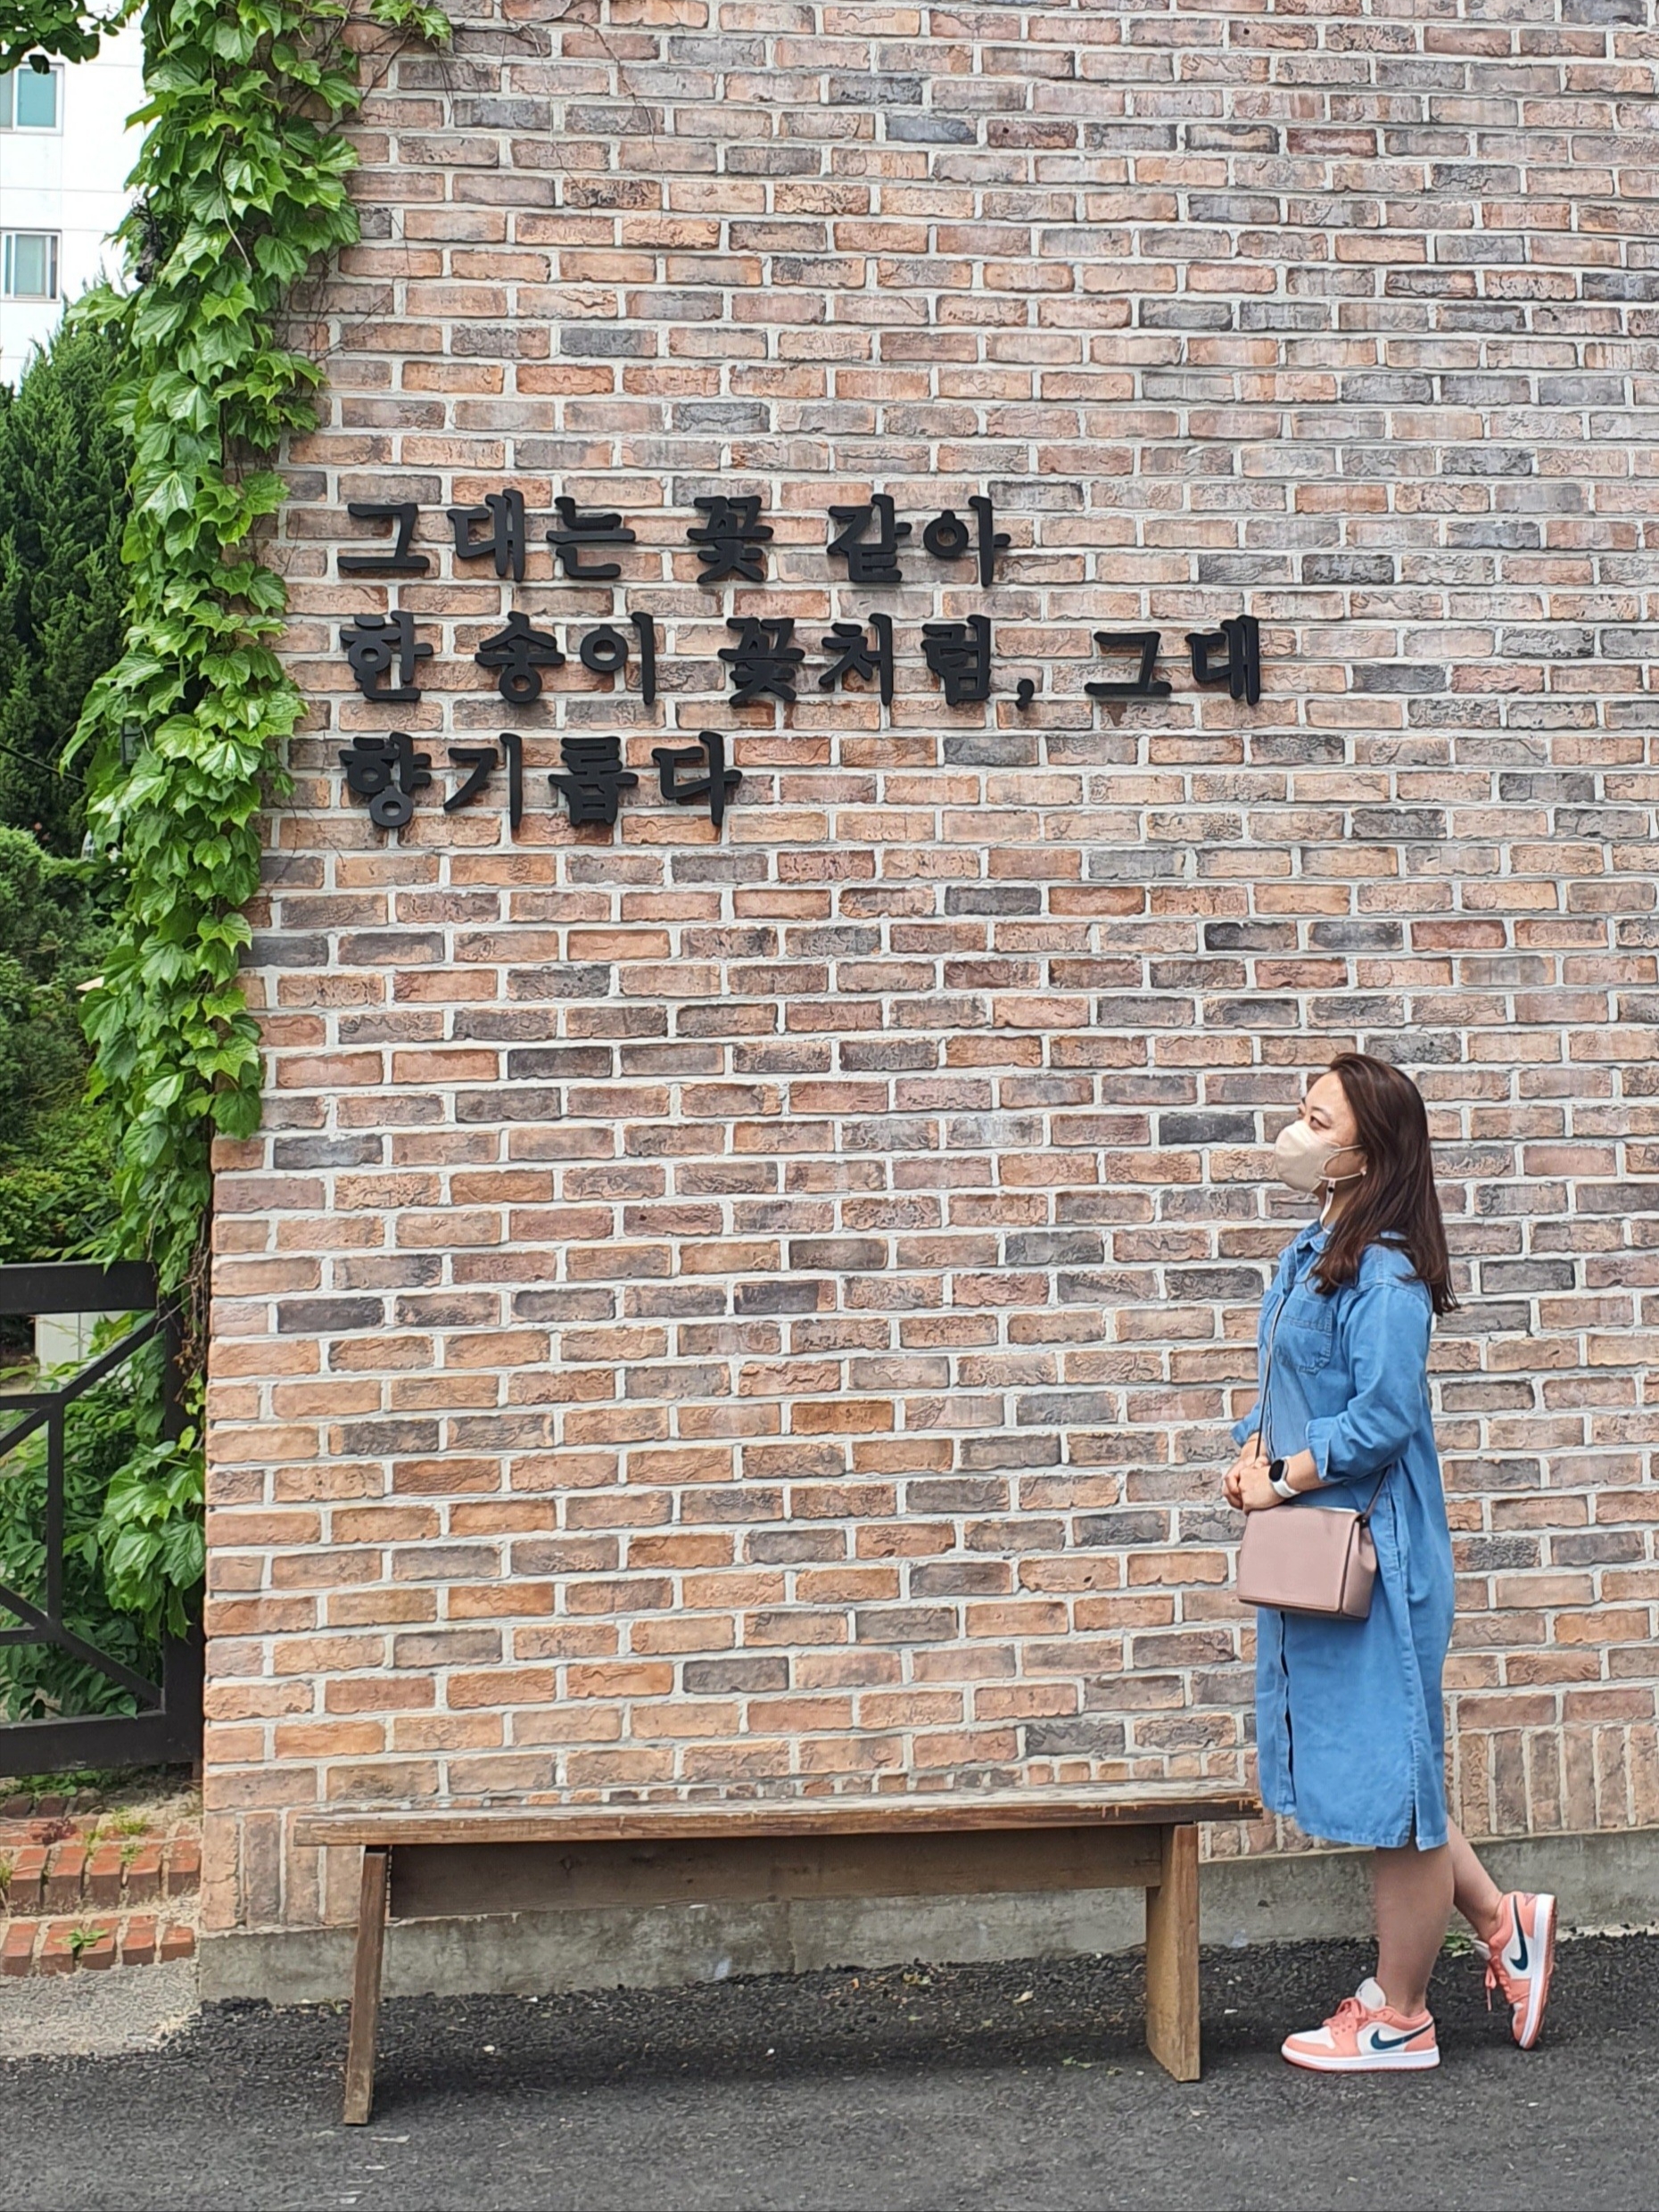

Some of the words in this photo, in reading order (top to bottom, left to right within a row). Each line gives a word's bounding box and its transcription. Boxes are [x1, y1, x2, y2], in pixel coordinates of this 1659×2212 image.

[337, 489, 636, 582] 그대는
[687, 496, 774, 583] 꽃
[827, 493, 1011, 587] 같아
[339, 611, 433, 702] 한
[475, 611, 656, 706] 송이
[718, 614, 1036, 711] 꽃처럼,
[1084, 615, 1261, 706] 그대
[338, 731, 743, 829] 향기롭다
